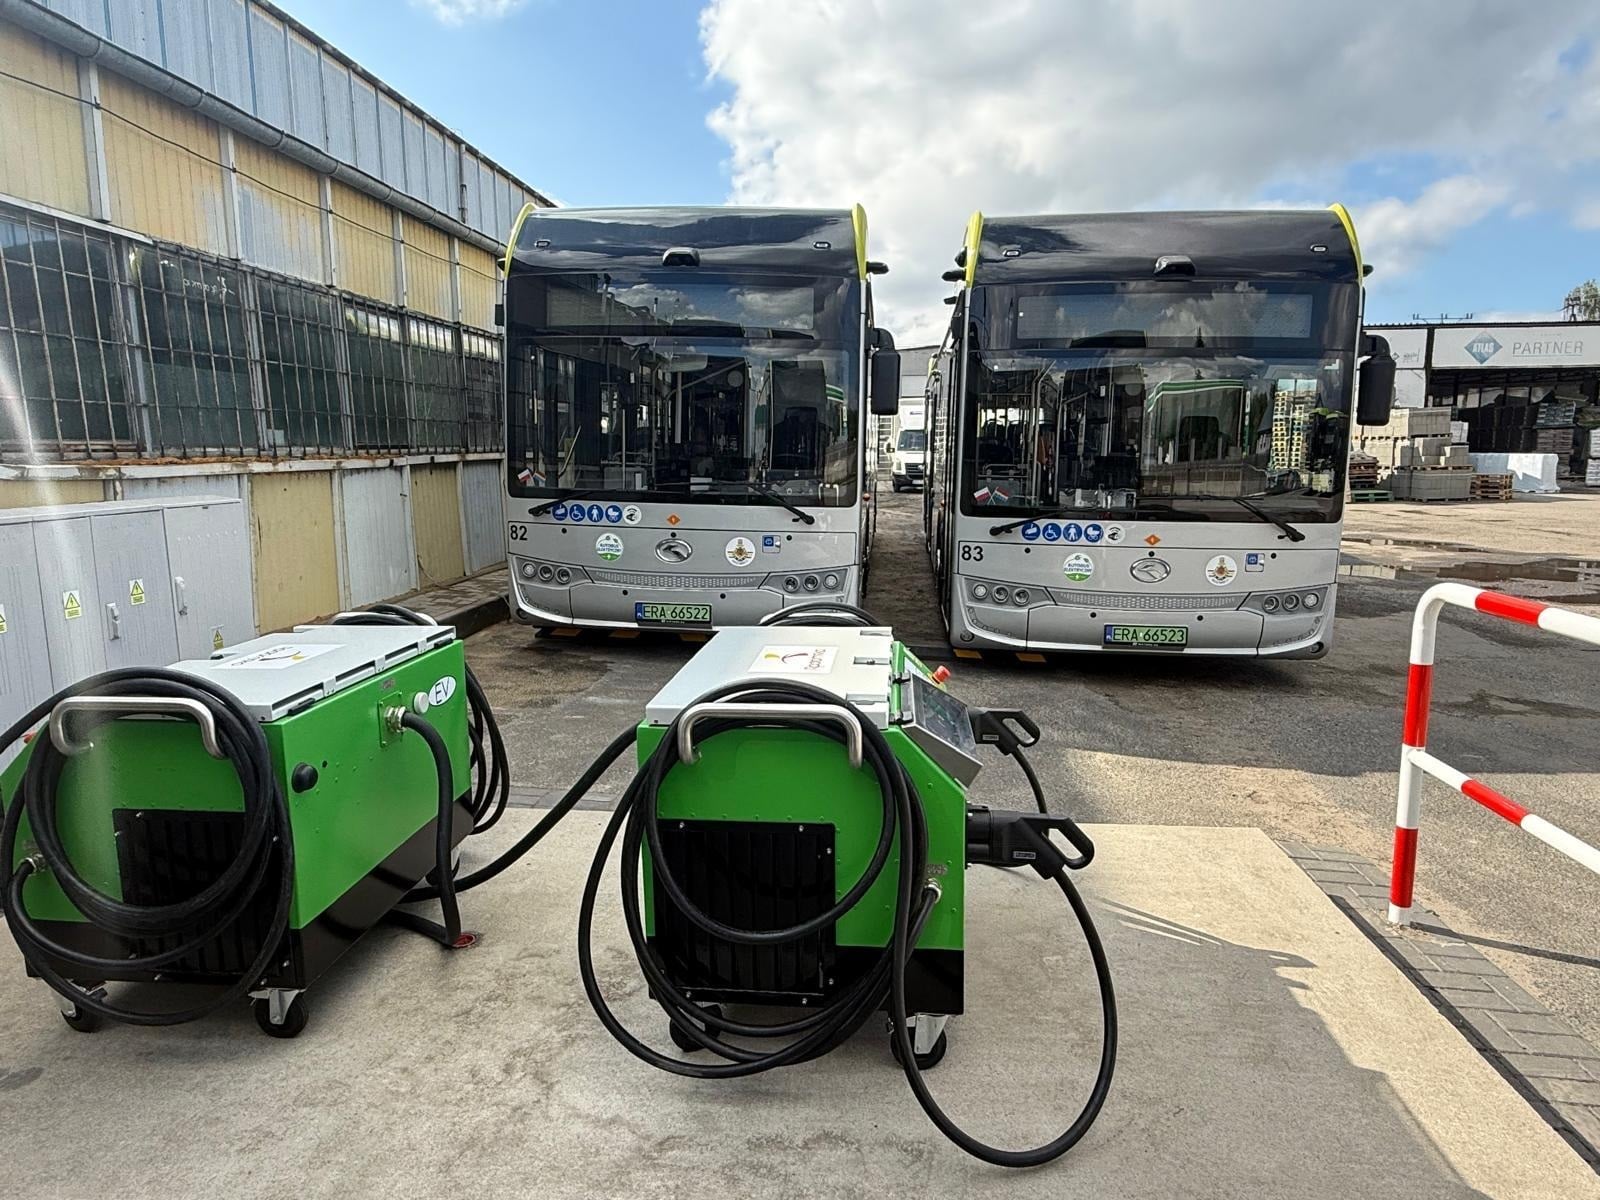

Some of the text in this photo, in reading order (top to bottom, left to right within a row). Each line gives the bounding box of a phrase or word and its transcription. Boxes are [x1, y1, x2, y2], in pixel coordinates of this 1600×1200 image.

[1472, 342, 1495, 354] ATLAS
[1512, 340, 1584, 355] PARTNER
[510, 525, 528, 541] 82
[961, 545, 984, 562] 83
[643, 605, 709, 620] ERA 66522
[1112, 627, 1185, 642] ERA 66523
[434, 677, 450, 705] EV
